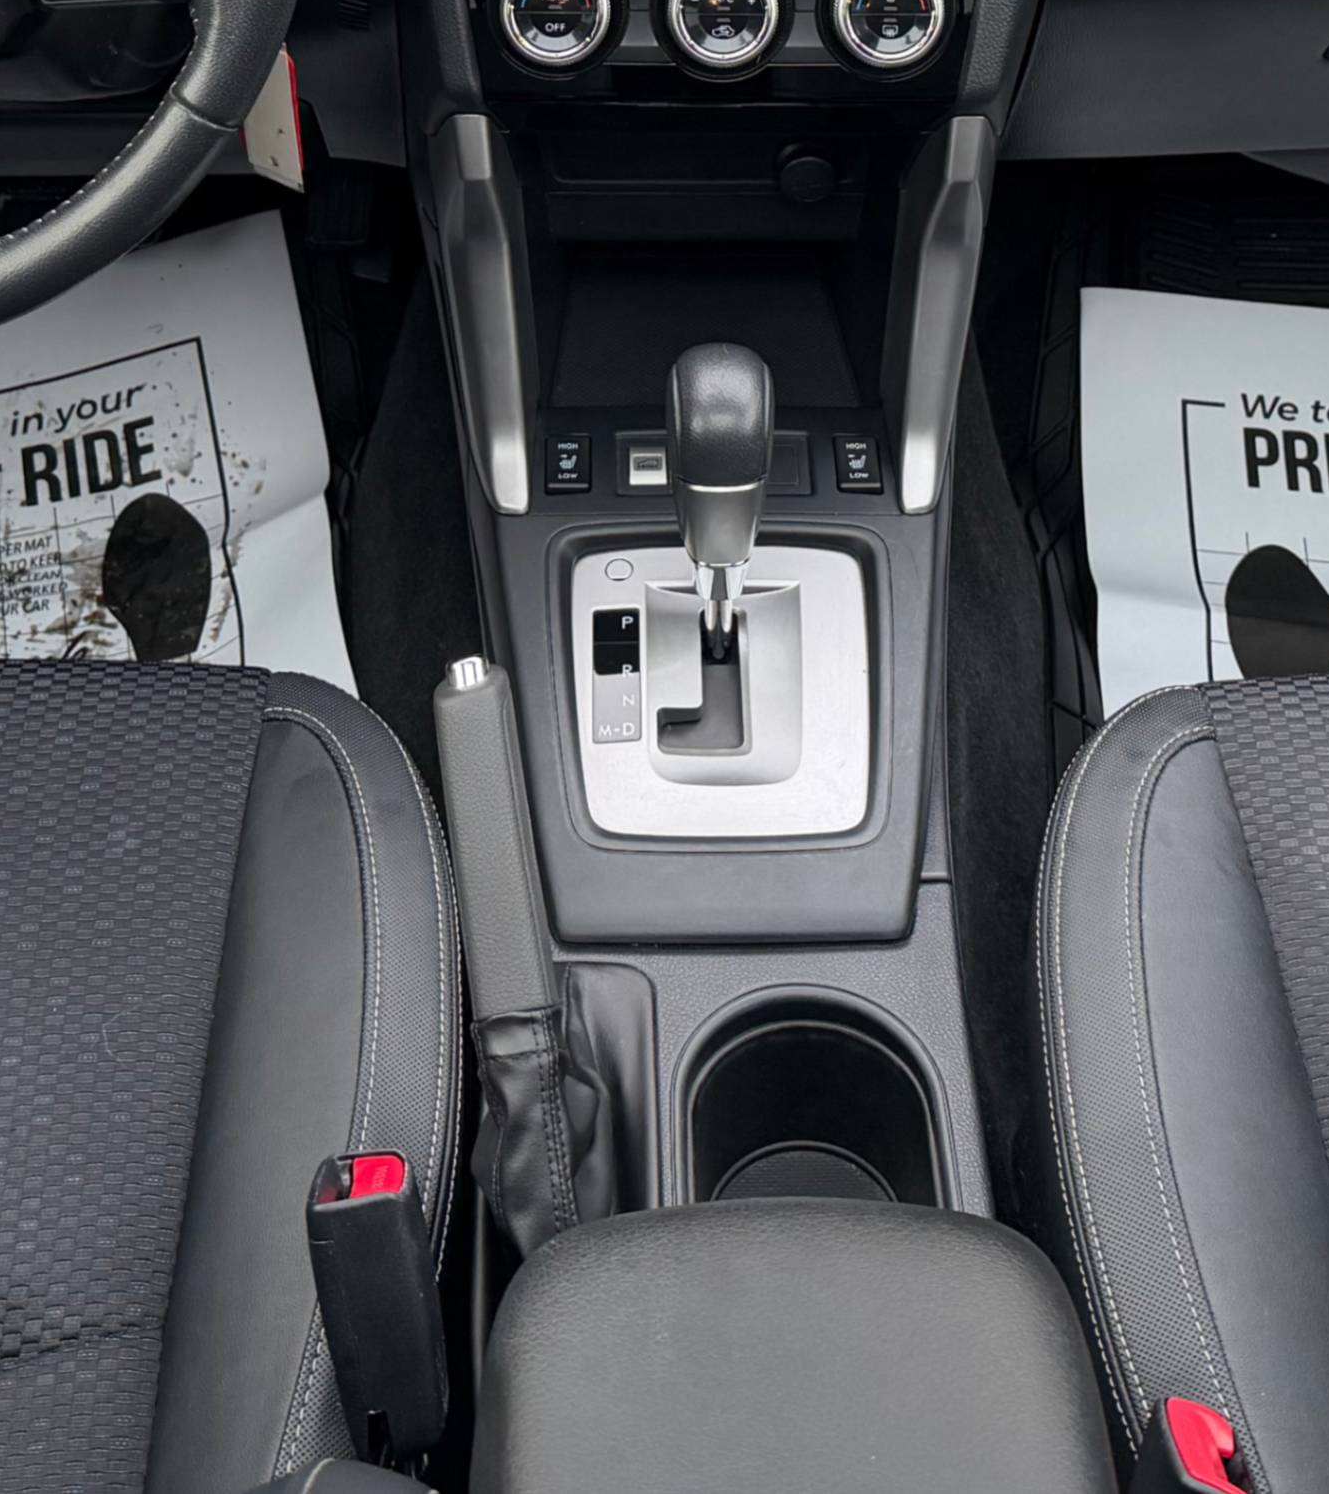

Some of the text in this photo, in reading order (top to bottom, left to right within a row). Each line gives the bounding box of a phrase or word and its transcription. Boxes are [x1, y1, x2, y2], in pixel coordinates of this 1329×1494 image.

[544, 21, 567, 33] OFF
[10, 410, 44, 437] in
[53, 383, 148, 433] your
[1241, 392, 1299, 422] We
[558, 442, 579, 451] HIGH
[845, 442, 867, 451] HIGH
[21, 415, 162, 507] RIDE
[558, 472, 579, 480] LOW
[848, 471, 869, 480] LOW
[25, 535, 53, 548] MAT
[31, 552, 61, 568] KEEP
[17, 569, 61, 584] CLEAN
[23, 598, 50, 614] CAR
[622, 615, 634, 630] P
[622, 664, 634, 678] R
[622, 694, 635, 708] N
